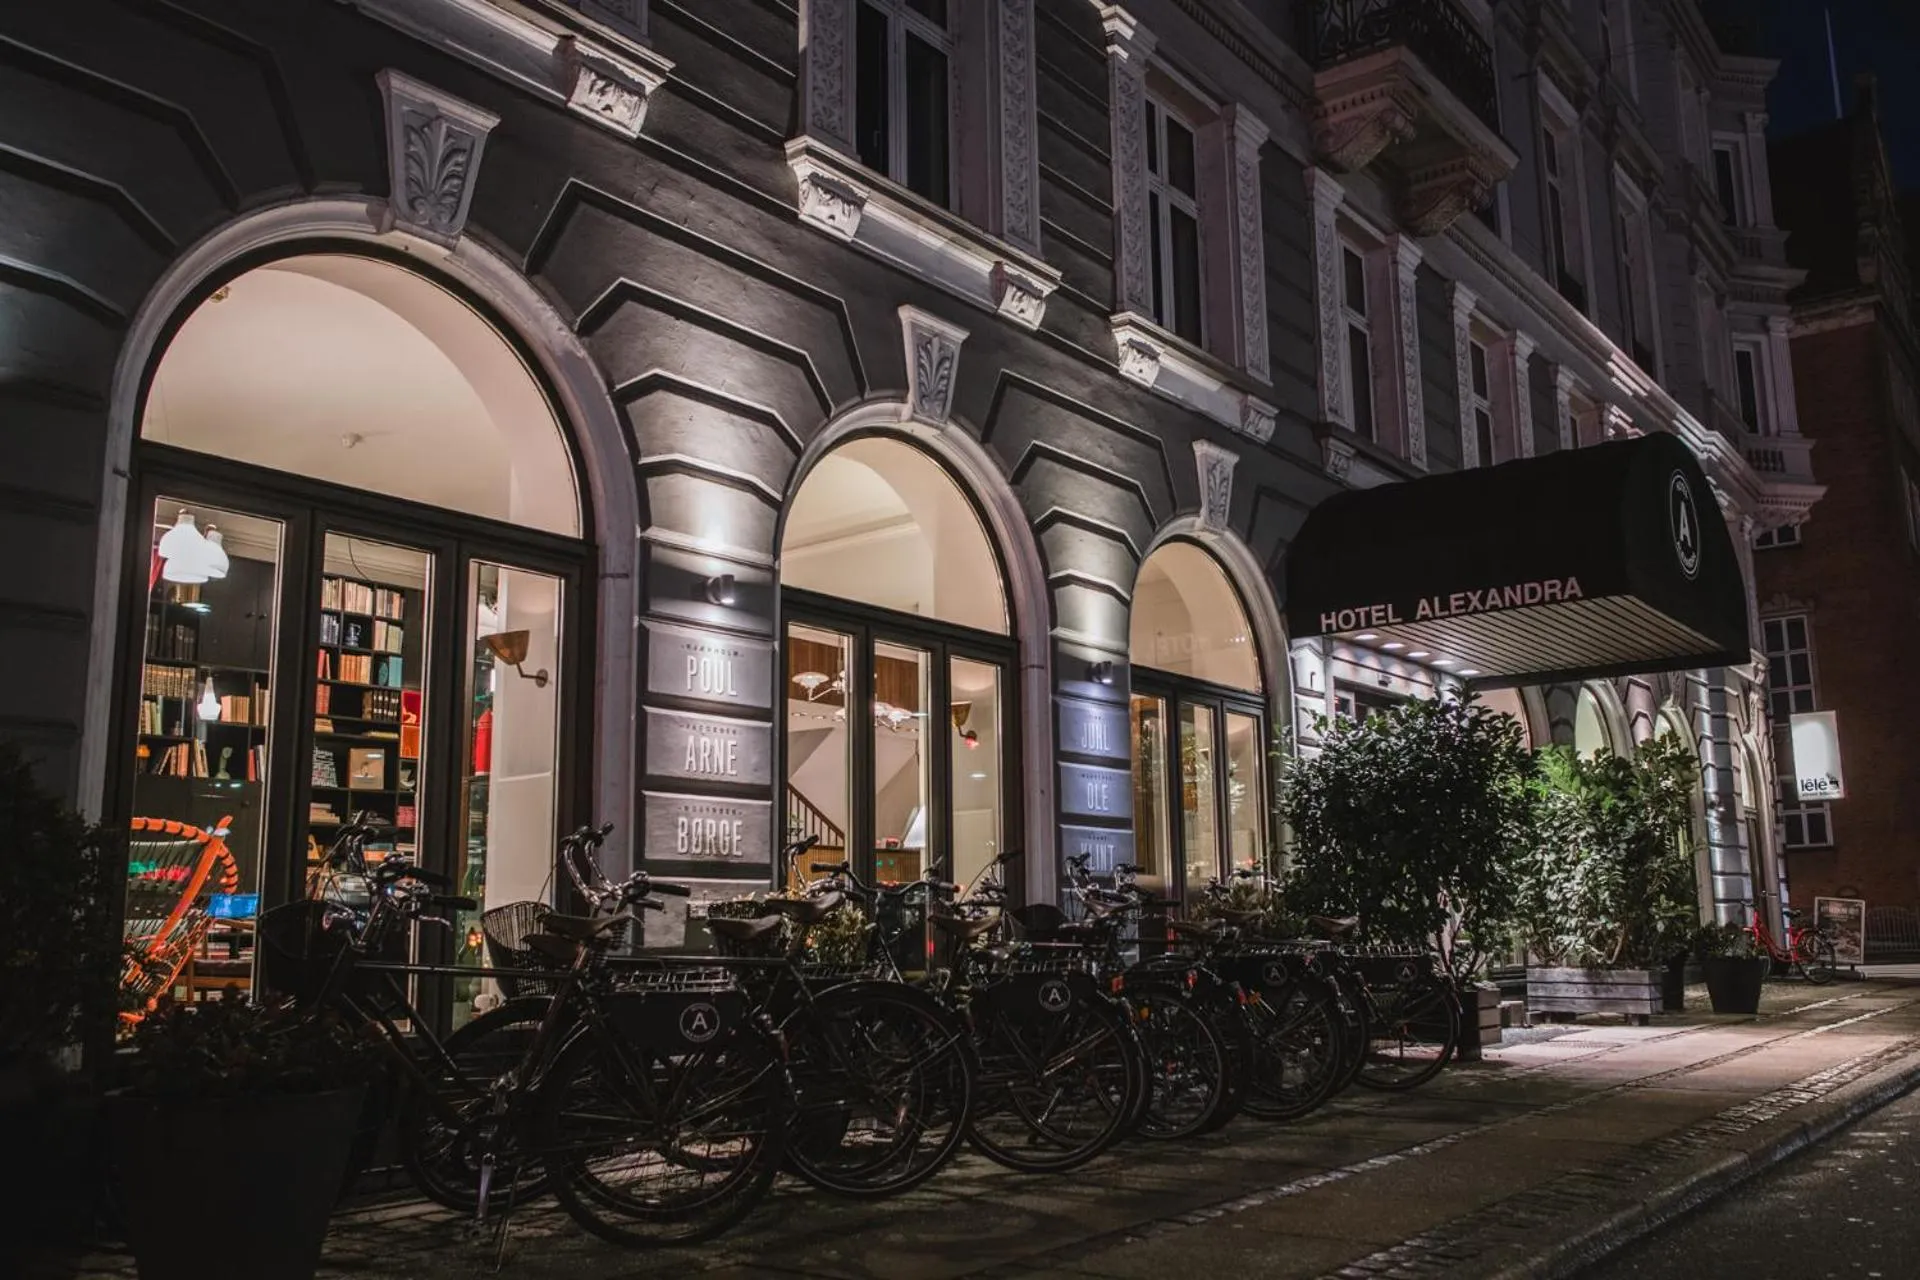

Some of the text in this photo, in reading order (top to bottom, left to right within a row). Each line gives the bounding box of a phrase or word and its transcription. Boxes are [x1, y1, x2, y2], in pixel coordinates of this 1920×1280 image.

[1320, 576, 1583, 633] HOTEL ALEXANDRA
[686, 655, 738, 696] POUL
[685, 735, 738, 776] ARNE
[1087, 782, 1109, 811] OLE
[677, 816, 744, 857] BØRGE
[1048, 987, 1062, 1002] A
[691, 1010, 709, 1031] A
